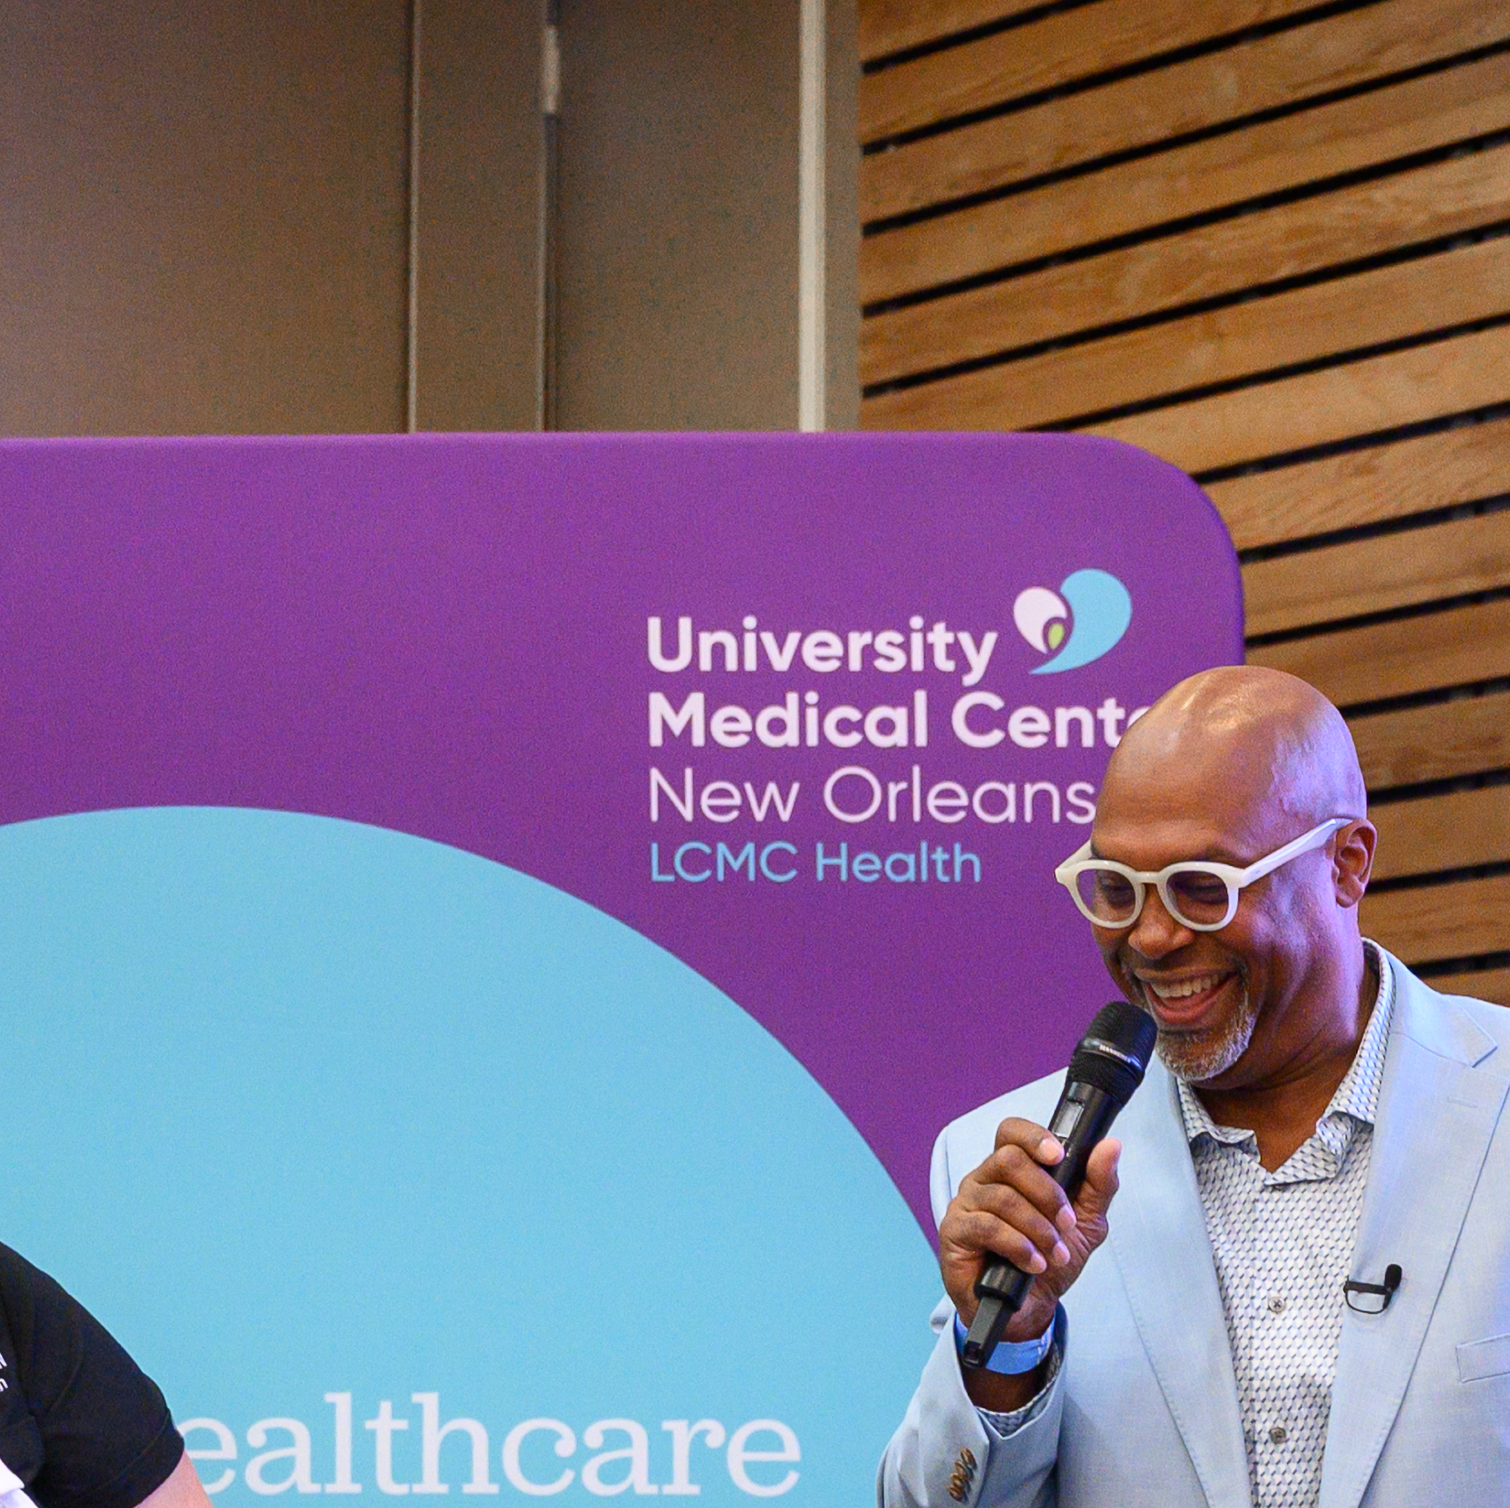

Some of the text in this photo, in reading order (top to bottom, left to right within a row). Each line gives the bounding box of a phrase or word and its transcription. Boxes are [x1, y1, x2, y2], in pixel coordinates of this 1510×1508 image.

[647, 615, 998, 686] University
[648, 690, 1148, 749] Medical Cent
[649, 765, 1097, 825] New Orleans
[650, 841, 981, 884] LCMC Health
[175, 1391, 801, 1498] ealthcare
